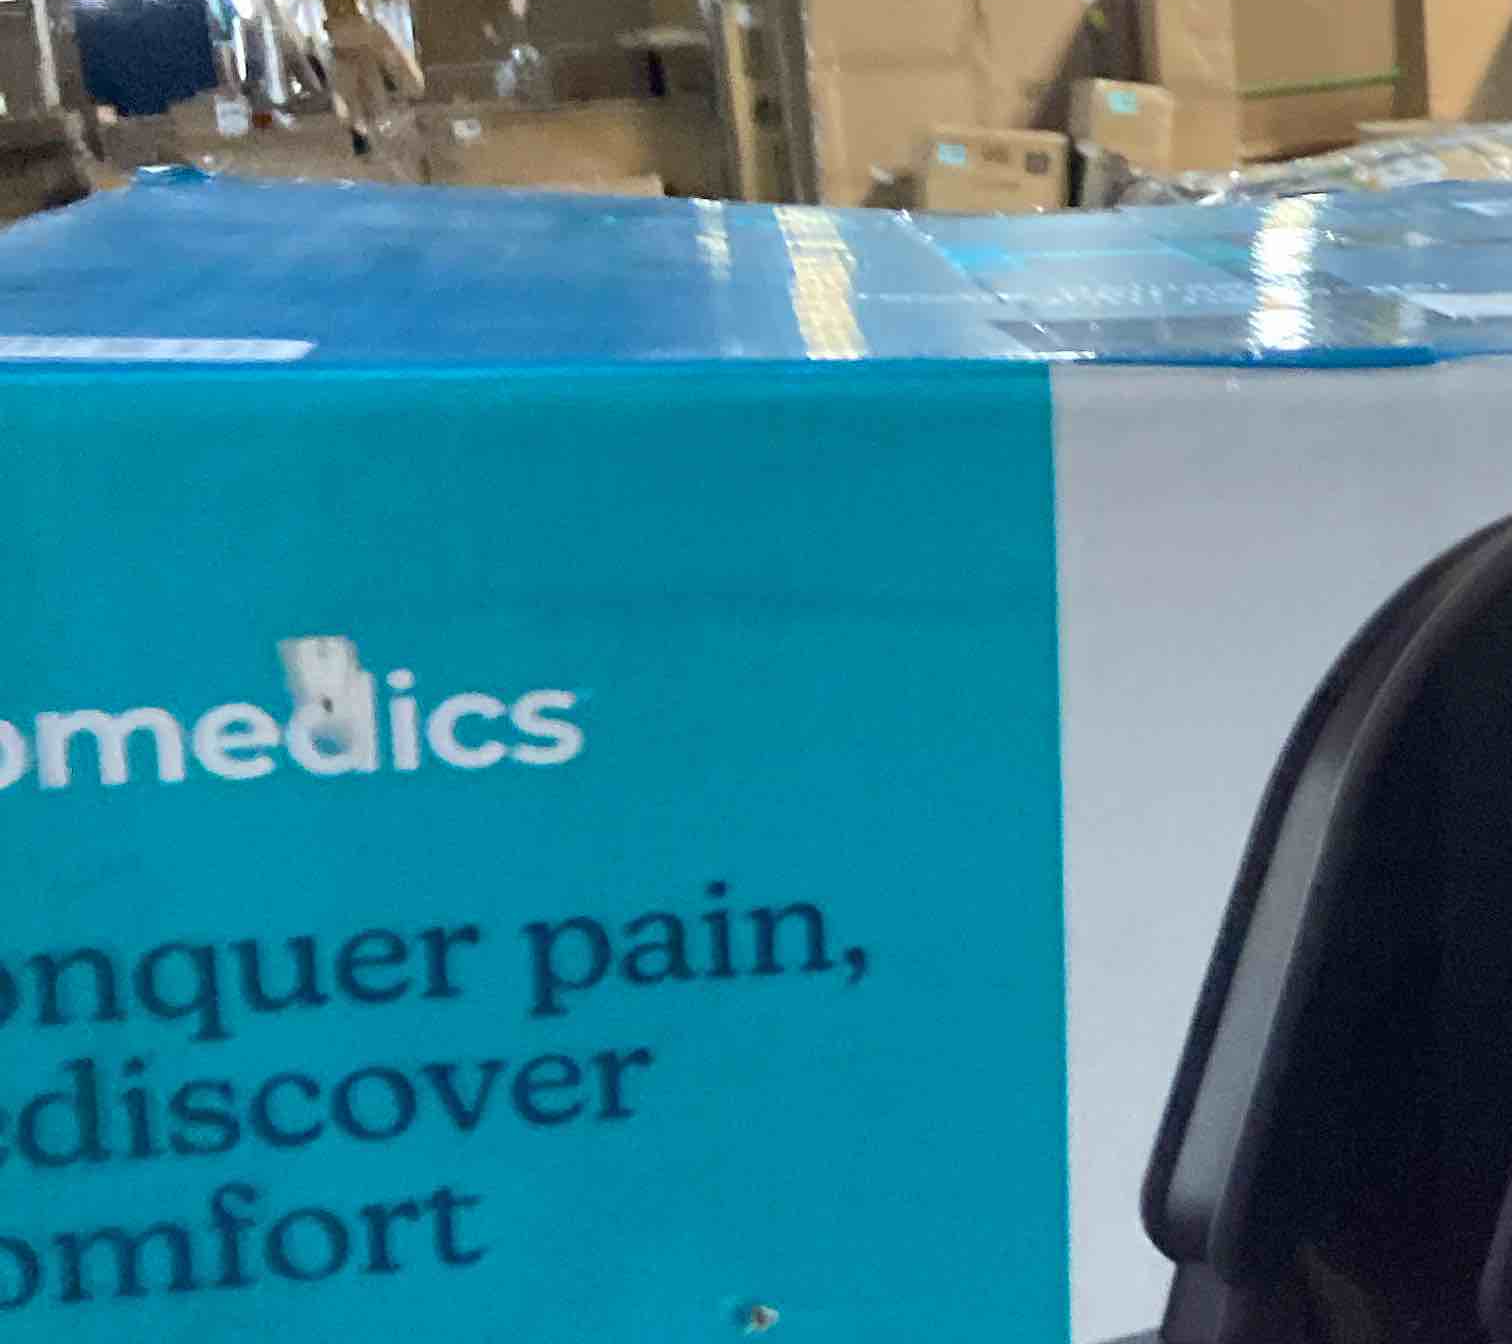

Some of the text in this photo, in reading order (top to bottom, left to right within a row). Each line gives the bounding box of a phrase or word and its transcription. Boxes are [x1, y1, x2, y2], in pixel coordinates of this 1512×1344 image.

[0, 879, 870, 1045] nquer pain,
[0, 1043, 656, 1171] discover
